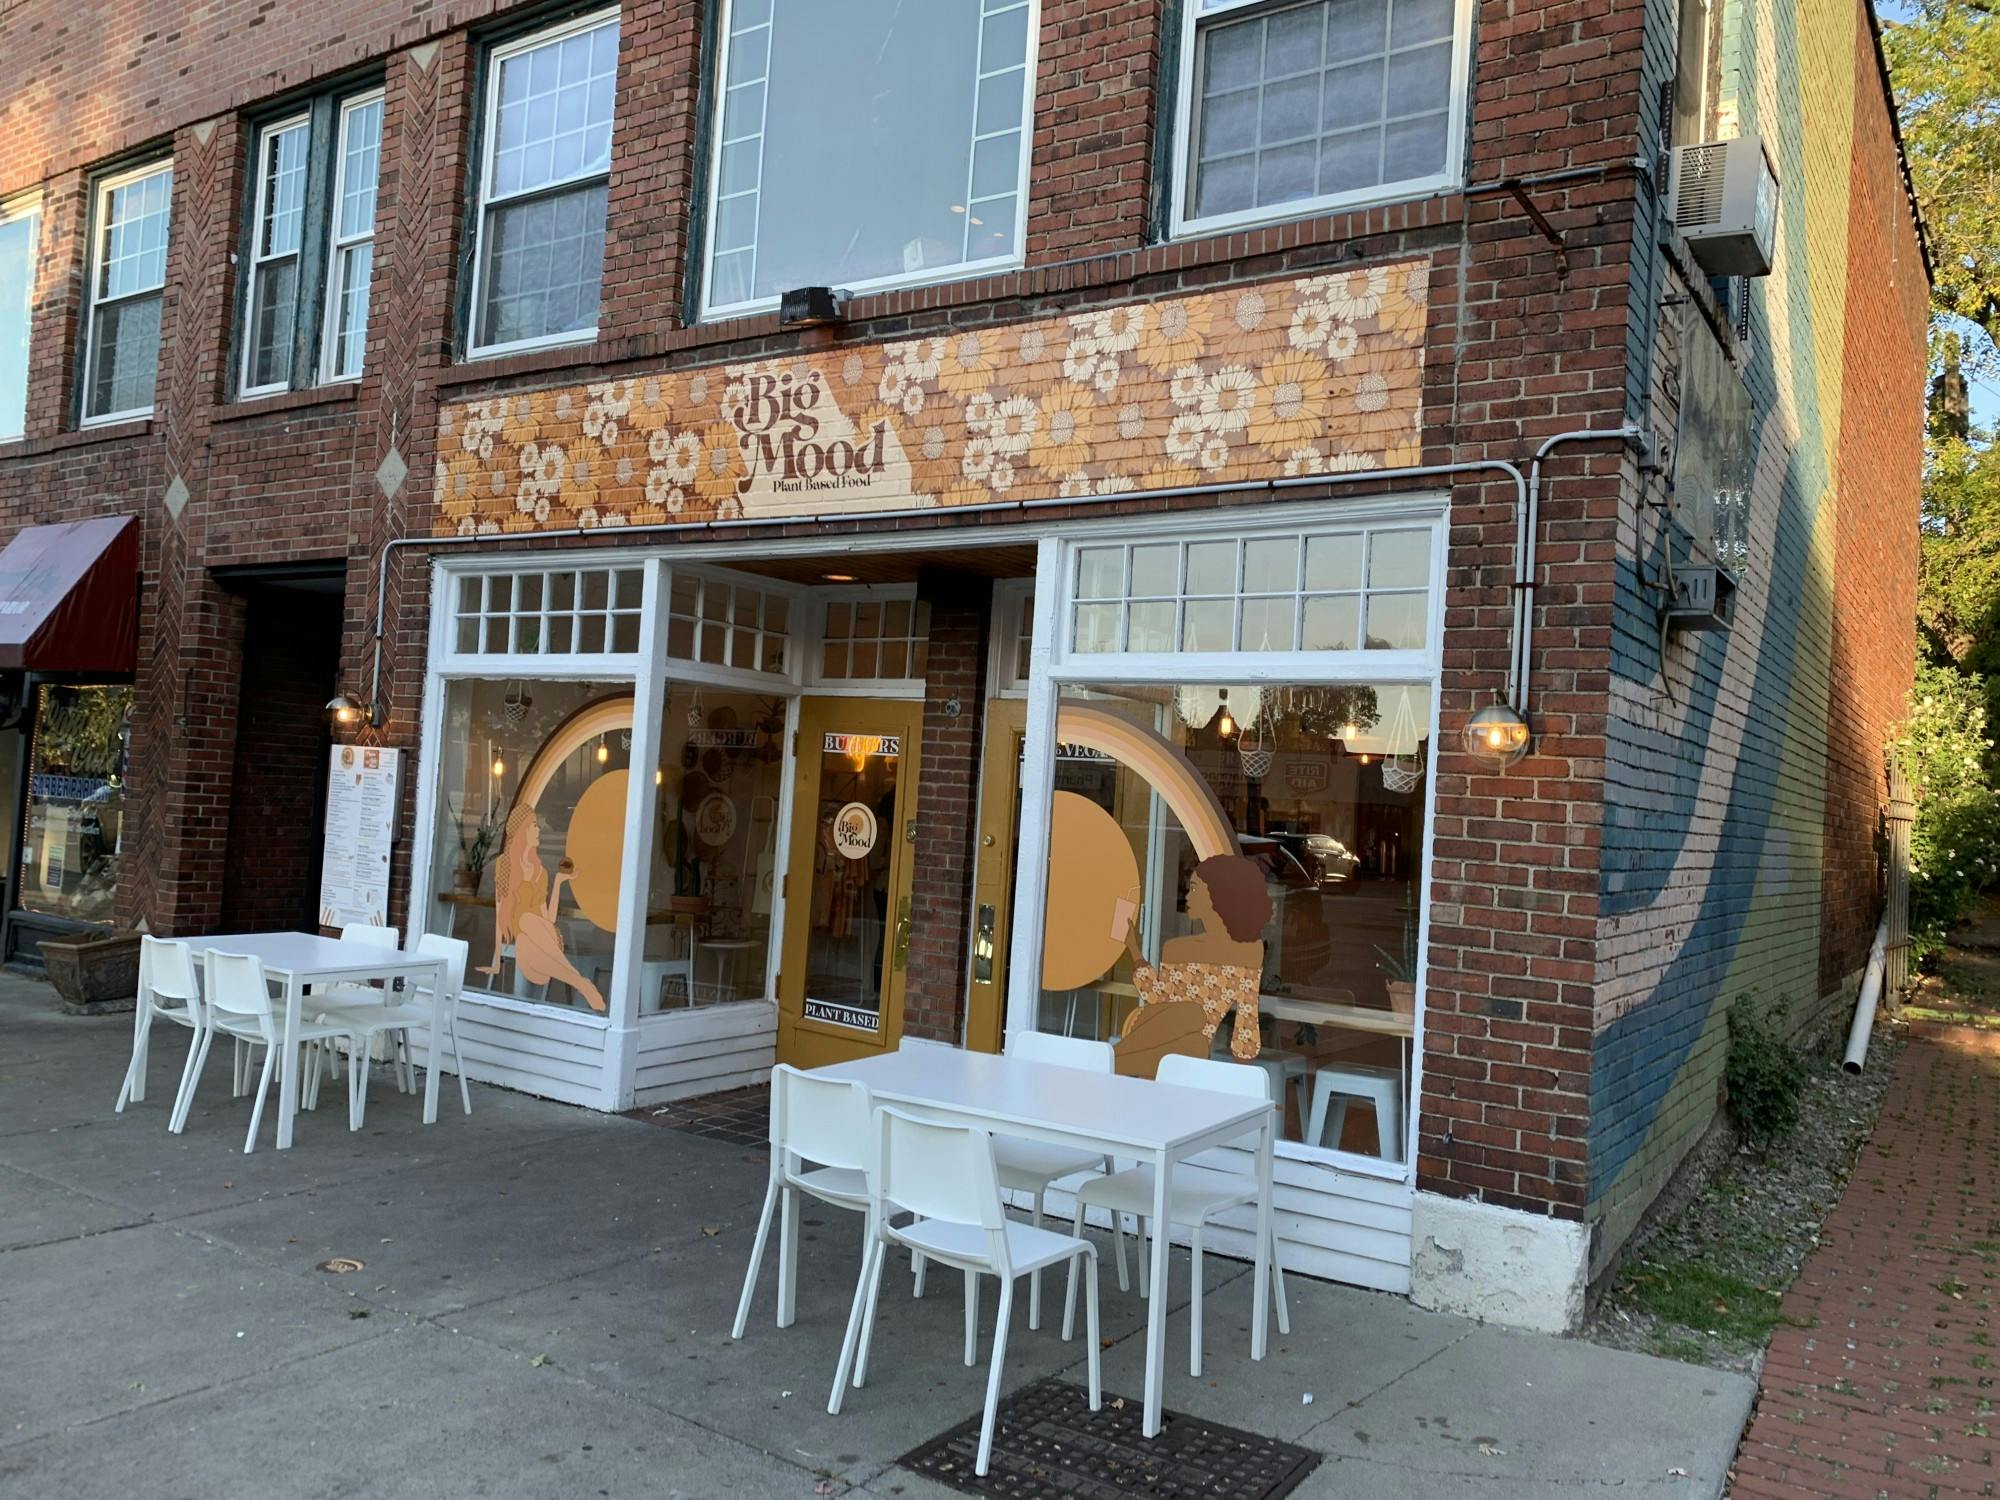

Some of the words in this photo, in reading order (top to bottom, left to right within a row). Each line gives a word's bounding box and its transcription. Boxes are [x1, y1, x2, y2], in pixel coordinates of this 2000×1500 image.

[733, 371, 820, 441] Big
[738, 421, 886, 494] Mood
[773, 480, 802, 492] Plant
[806, 476, 840, 490] Based
[842, 475, 871, 488] Food
[824, 736, 899, 753] BURS
[838, 821, 858, 837] Big
[838, 831, 871, 848] Mood
[805, 1003, 841, 1020] PLANT
[843, 1011, 879, 1028] BASED
